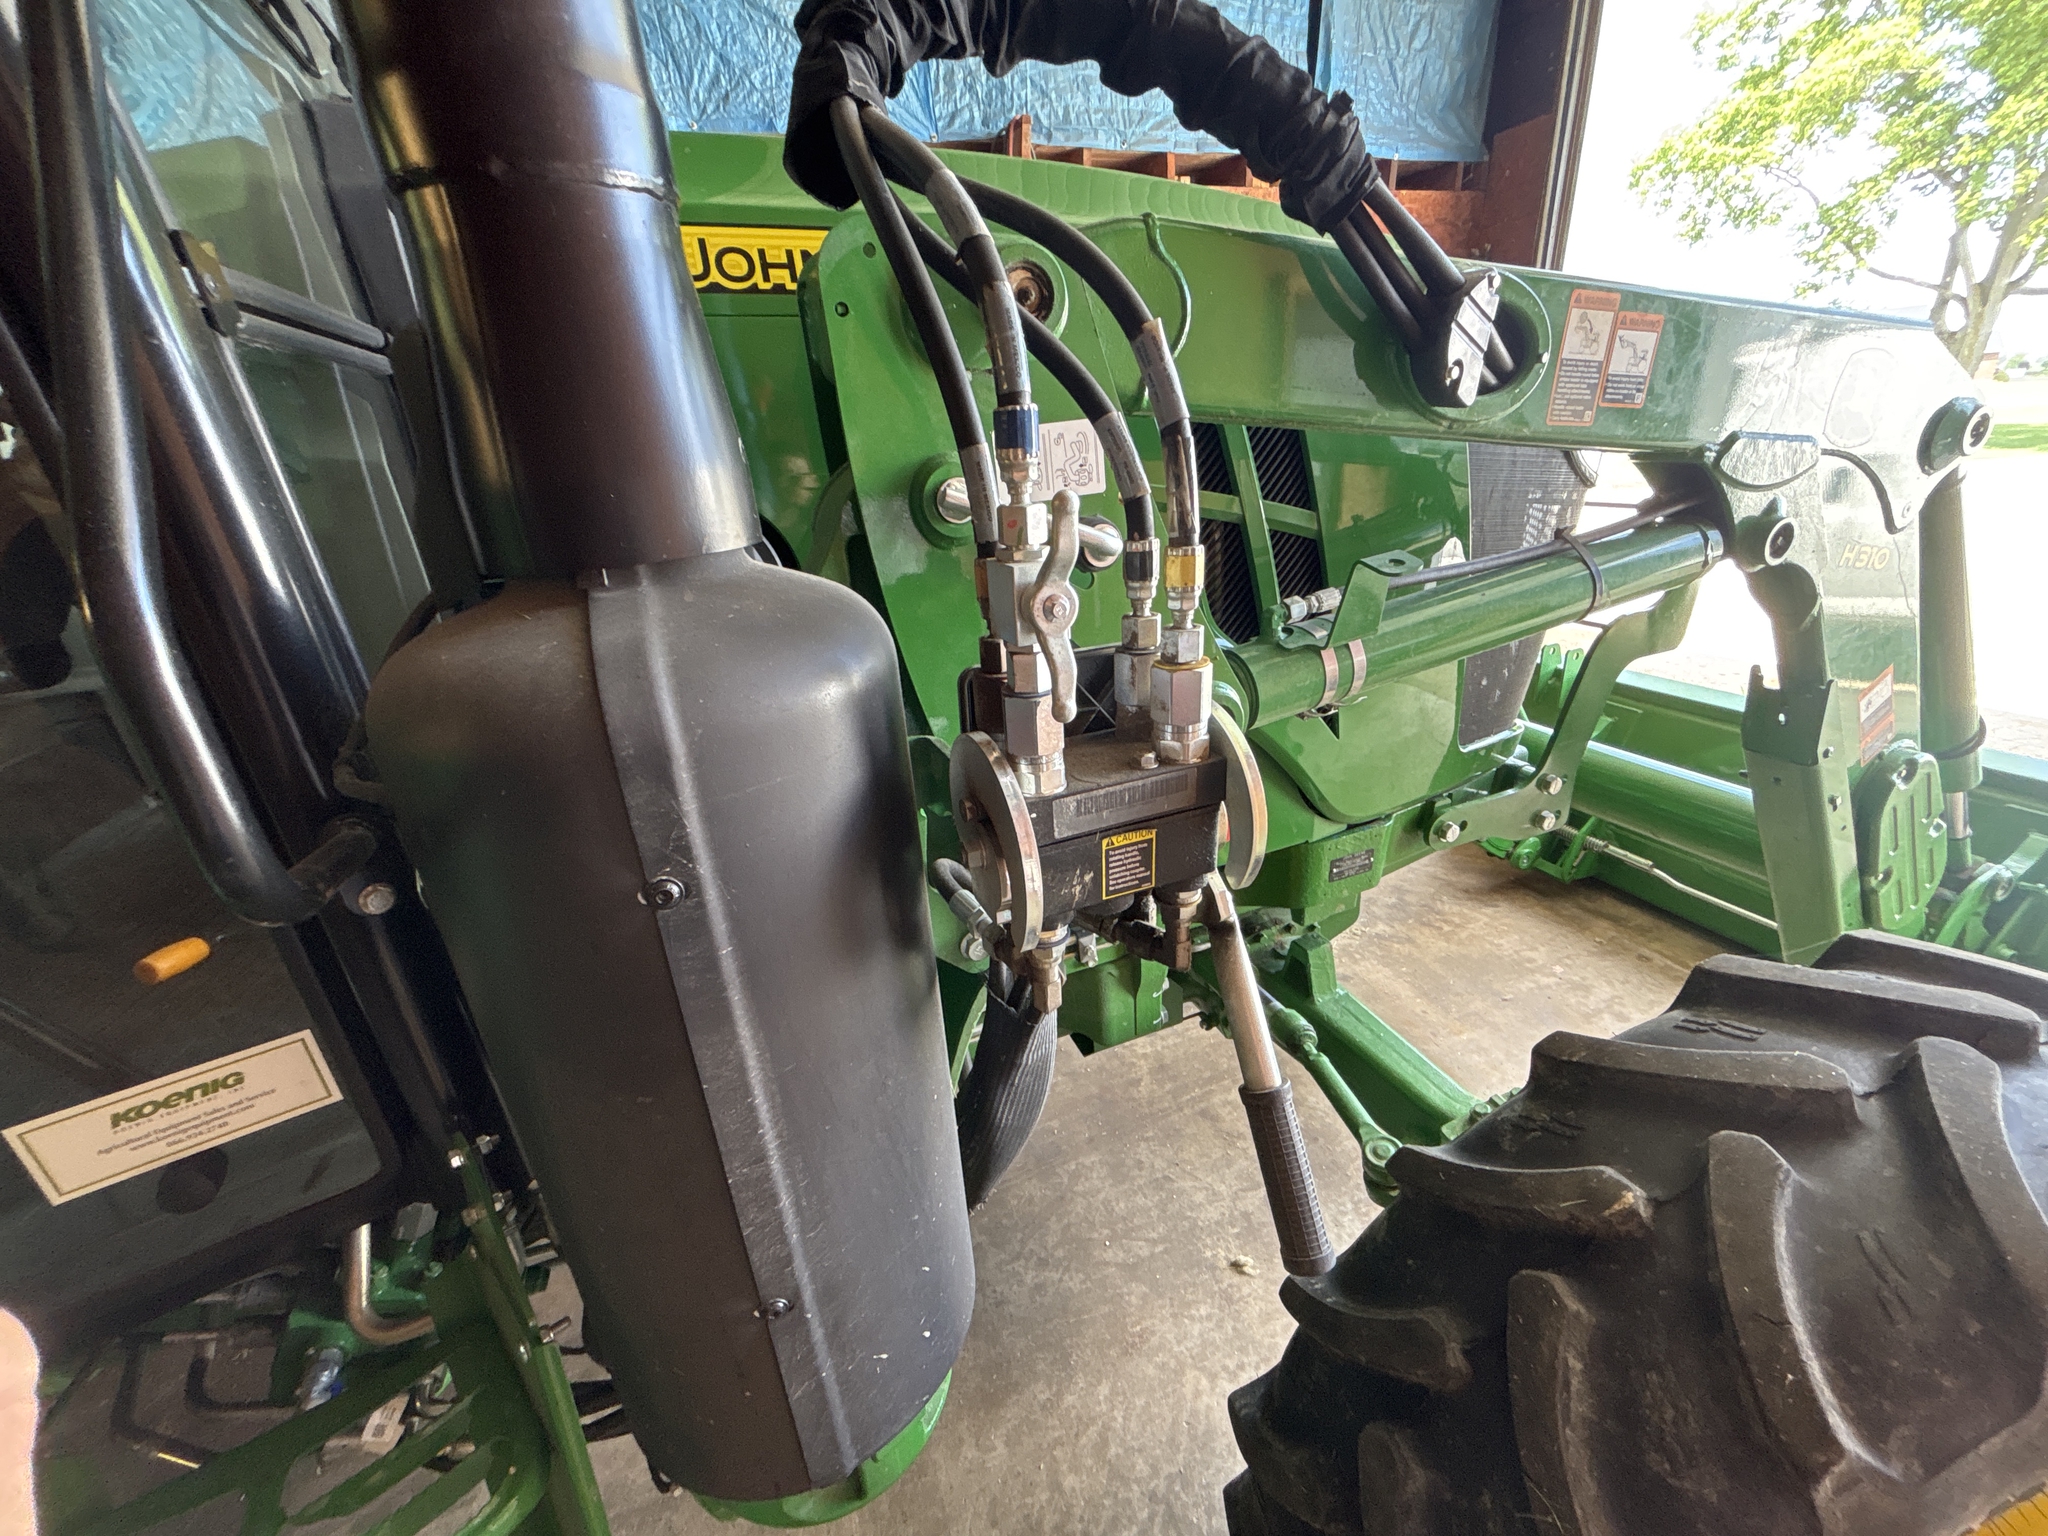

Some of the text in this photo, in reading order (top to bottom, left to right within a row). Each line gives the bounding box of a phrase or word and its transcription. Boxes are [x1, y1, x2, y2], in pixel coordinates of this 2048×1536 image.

[692, 237, 814, 283] JOH
[1838, 543, 1891, 571] H310
[1116, 829, 1153, 844] CAUTION
